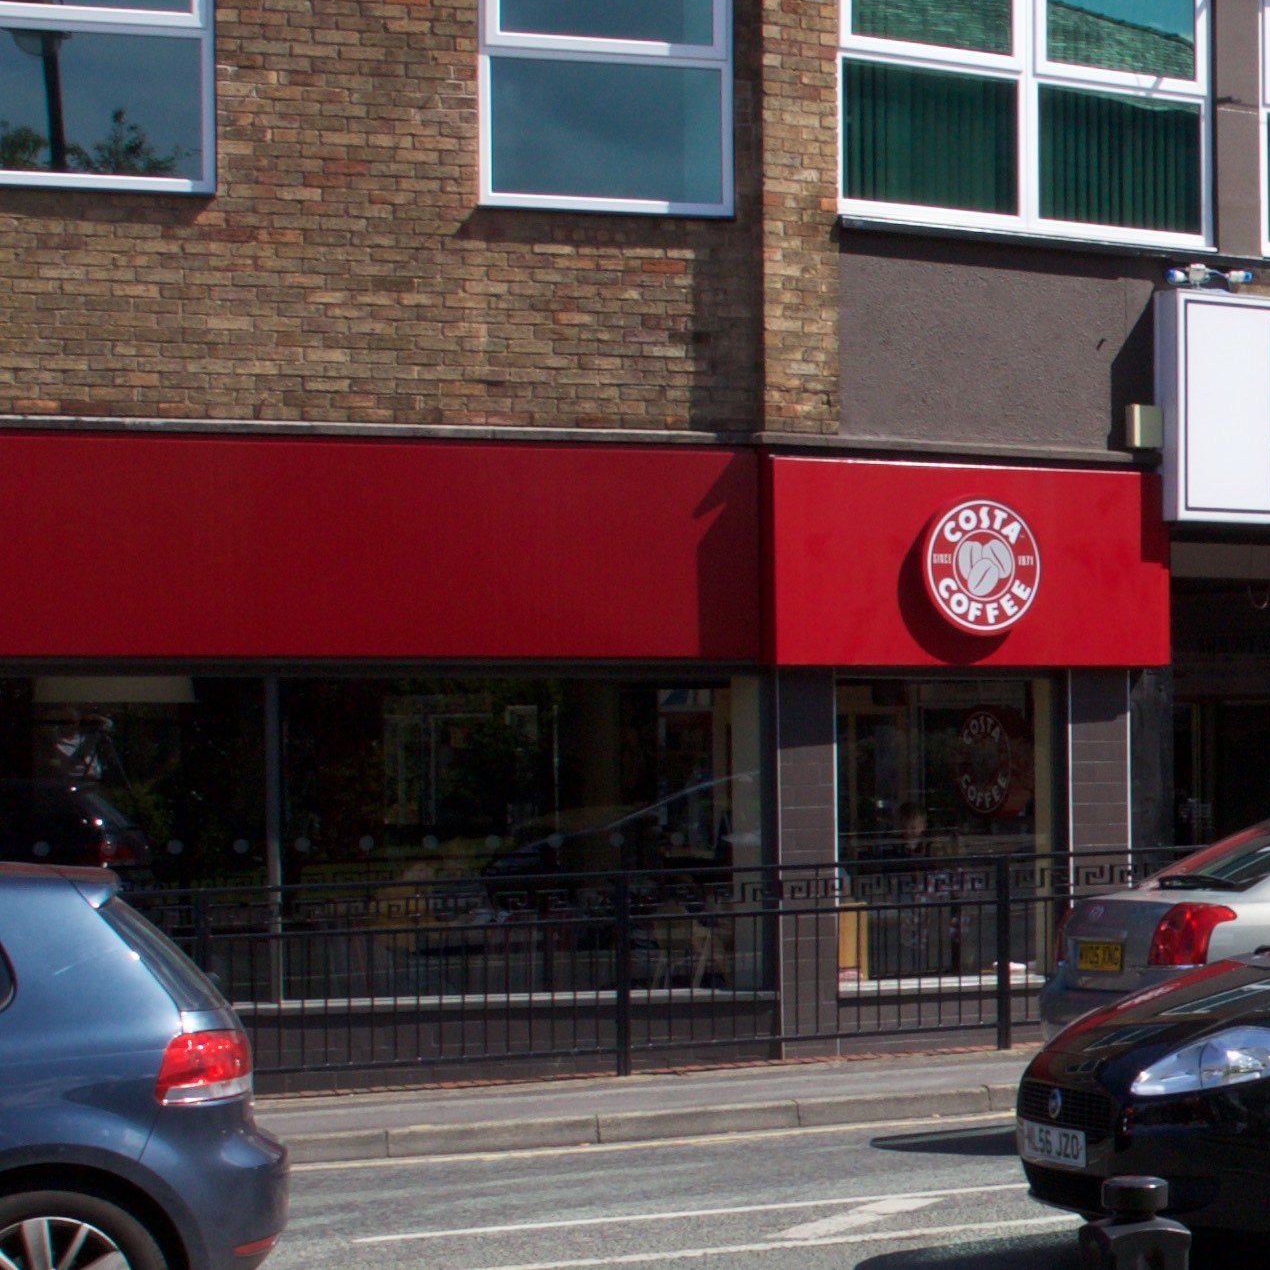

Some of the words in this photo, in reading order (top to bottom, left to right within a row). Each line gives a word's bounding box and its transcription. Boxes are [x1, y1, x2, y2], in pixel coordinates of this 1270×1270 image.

[943, 506, 1022, 544] COSTA
[938, 577, 1032, 624] COFFEE
[1056, 1130, 1080, 1161] JZO
